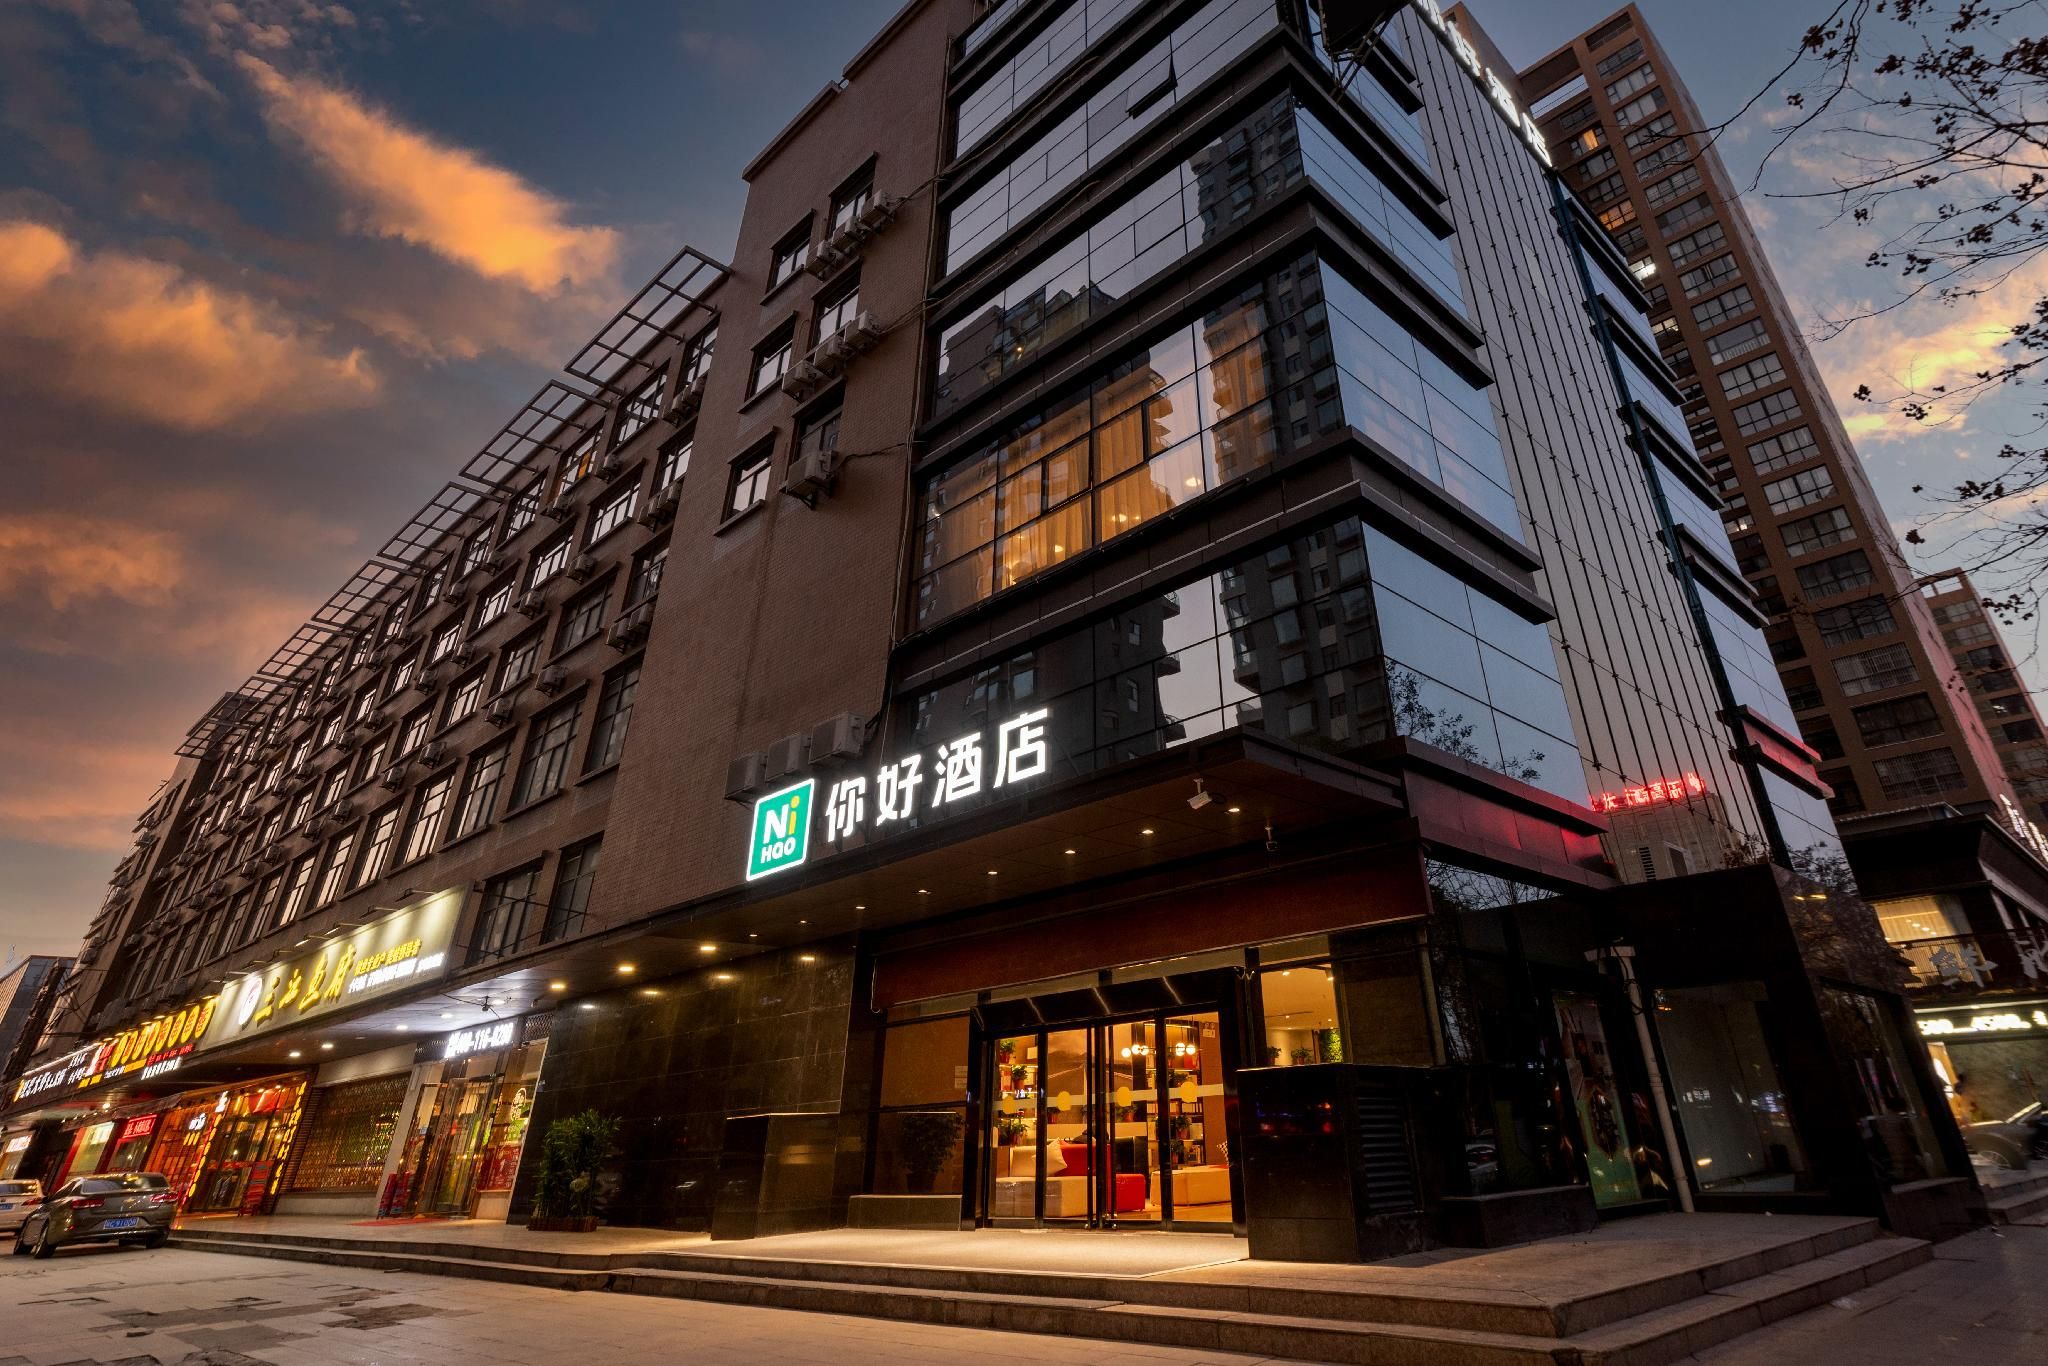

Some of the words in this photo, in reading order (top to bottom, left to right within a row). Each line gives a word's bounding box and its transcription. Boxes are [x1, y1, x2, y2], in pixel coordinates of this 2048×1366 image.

[763, 795, 801, 845] Ni
[824, 707, 1049, 843] 你好酒店
